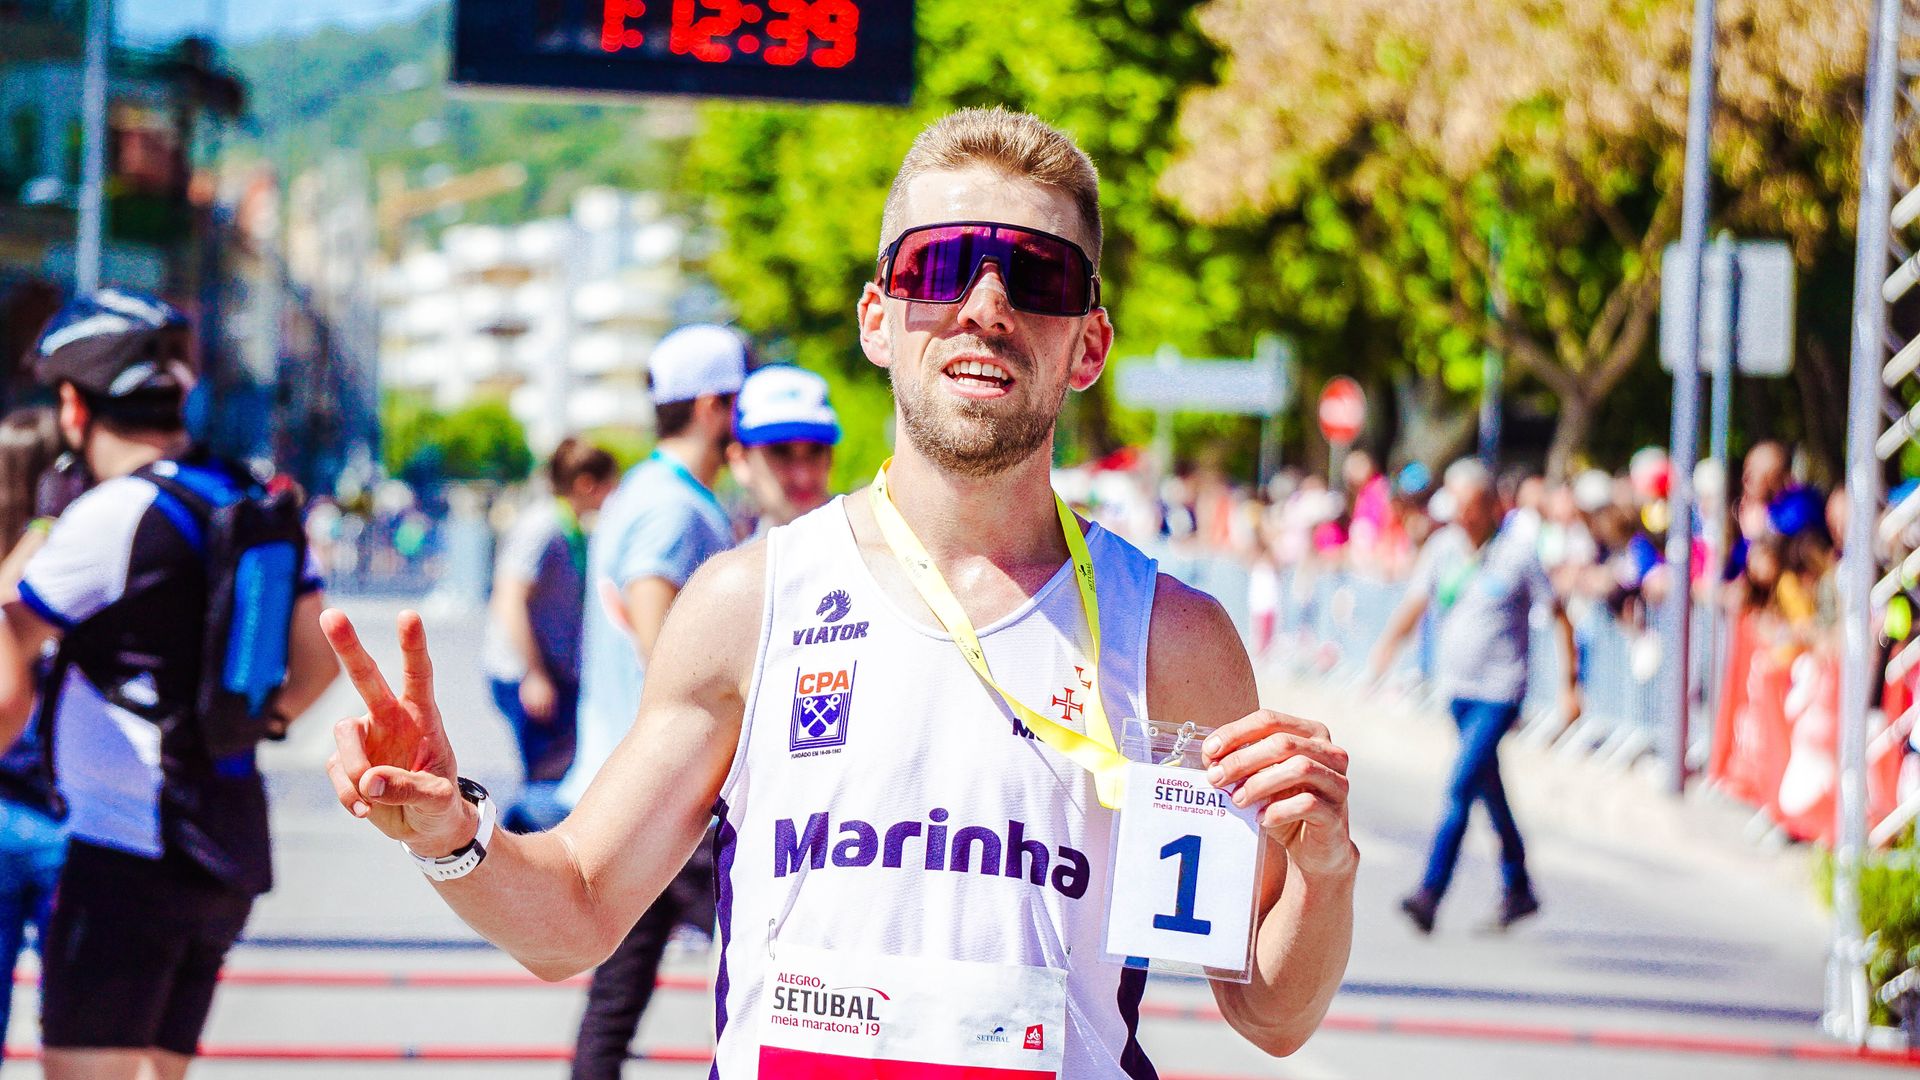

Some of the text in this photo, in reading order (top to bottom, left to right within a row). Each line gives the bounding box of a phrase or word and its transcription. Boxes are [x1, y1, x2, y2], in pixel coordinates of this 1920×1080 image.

[792, 621, 870, 646] VIATOR
[798, 670, 850, 695] CPA
[1156, 778, 1190, 788] ALEGRO
[1153, 802, 1173, 810] meia
[1154, 785, 1227, 808] SETÚBAL
[774, 808, 1091, 900] Marinha
[1153, 834, 1212, 936] 1
[777, 972, 821, 988] ALEGRO
[773, 984, 880, 1021] SETÚBAL
[771, 1014, 799, 1027] meia
